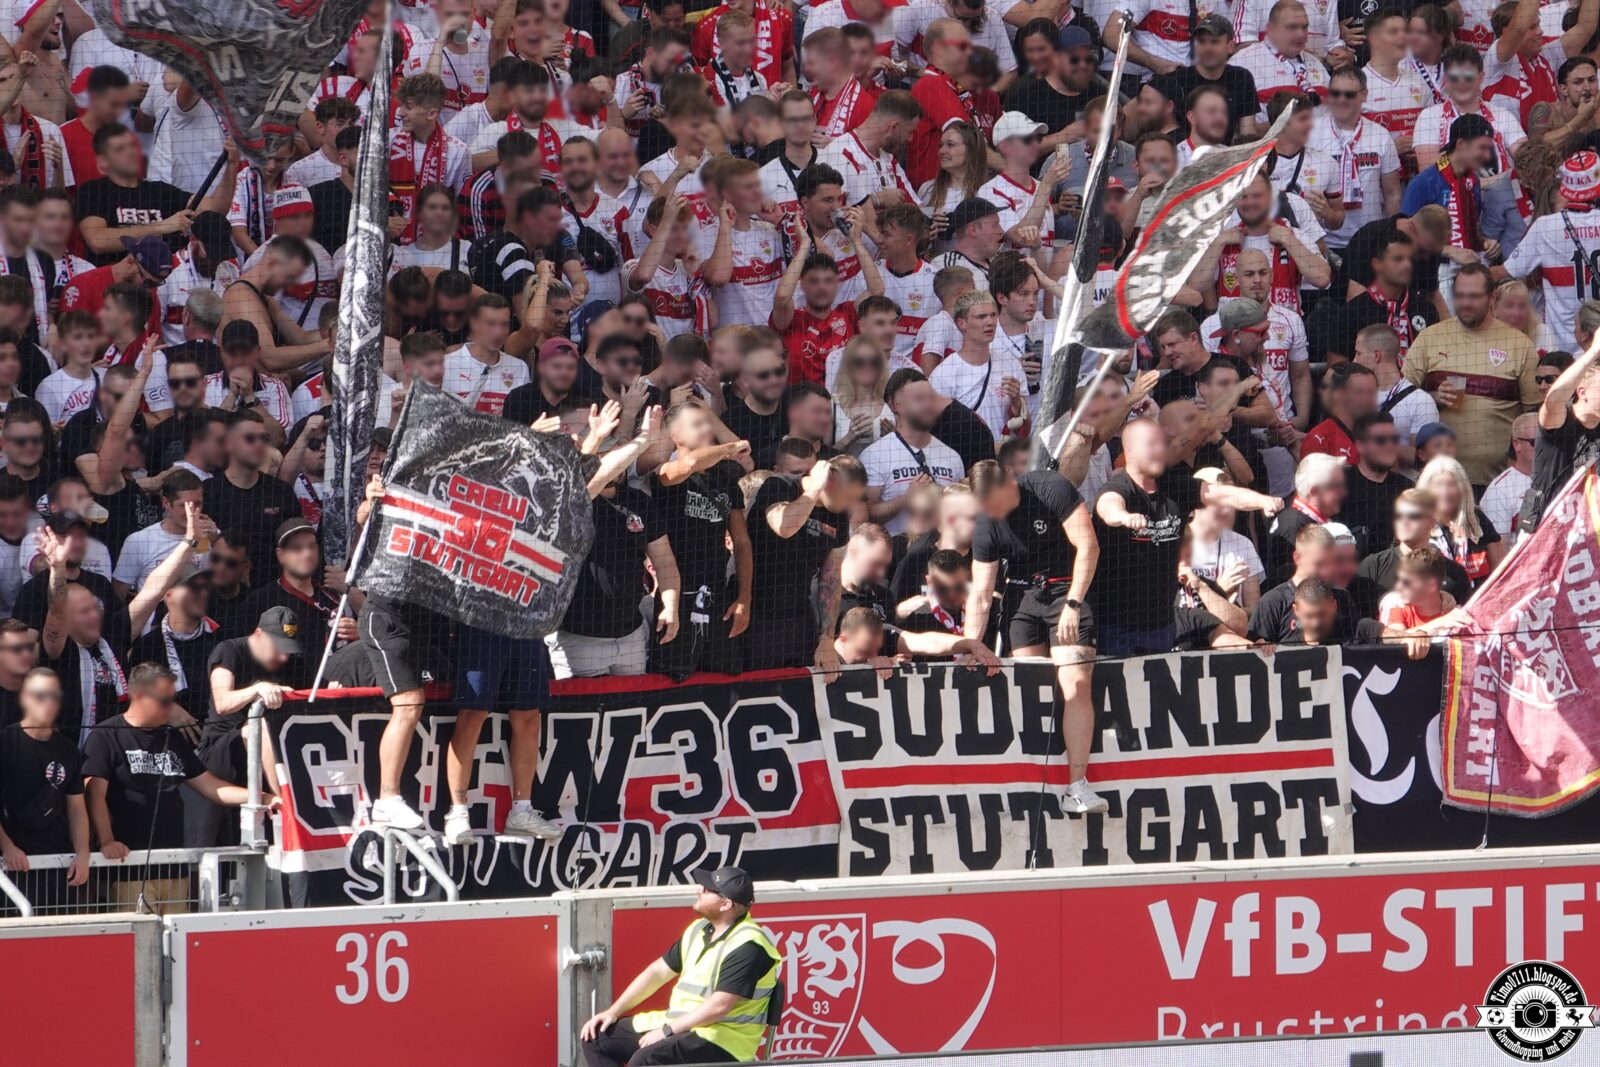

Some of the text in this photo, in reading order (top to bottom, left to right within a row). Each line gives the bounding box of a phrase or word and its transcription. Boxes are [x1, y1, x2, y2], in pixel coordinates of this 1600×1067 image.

[449, 474, 529, 524] CREW
[892, 466, 953, 480] SÜDNDE
[387, 525, 541, 607] STUTTGART
[443, 500, 516, 564] 36
[826, 649, 1332, 762] SÜDBANDE
[849, 777, 1340, 877] STUTTGART
[335, 930, 410, 1005] 36
[1147, 882, 1600, 981] VfB-STIF
[811, 1000, 831, 1016] 93
